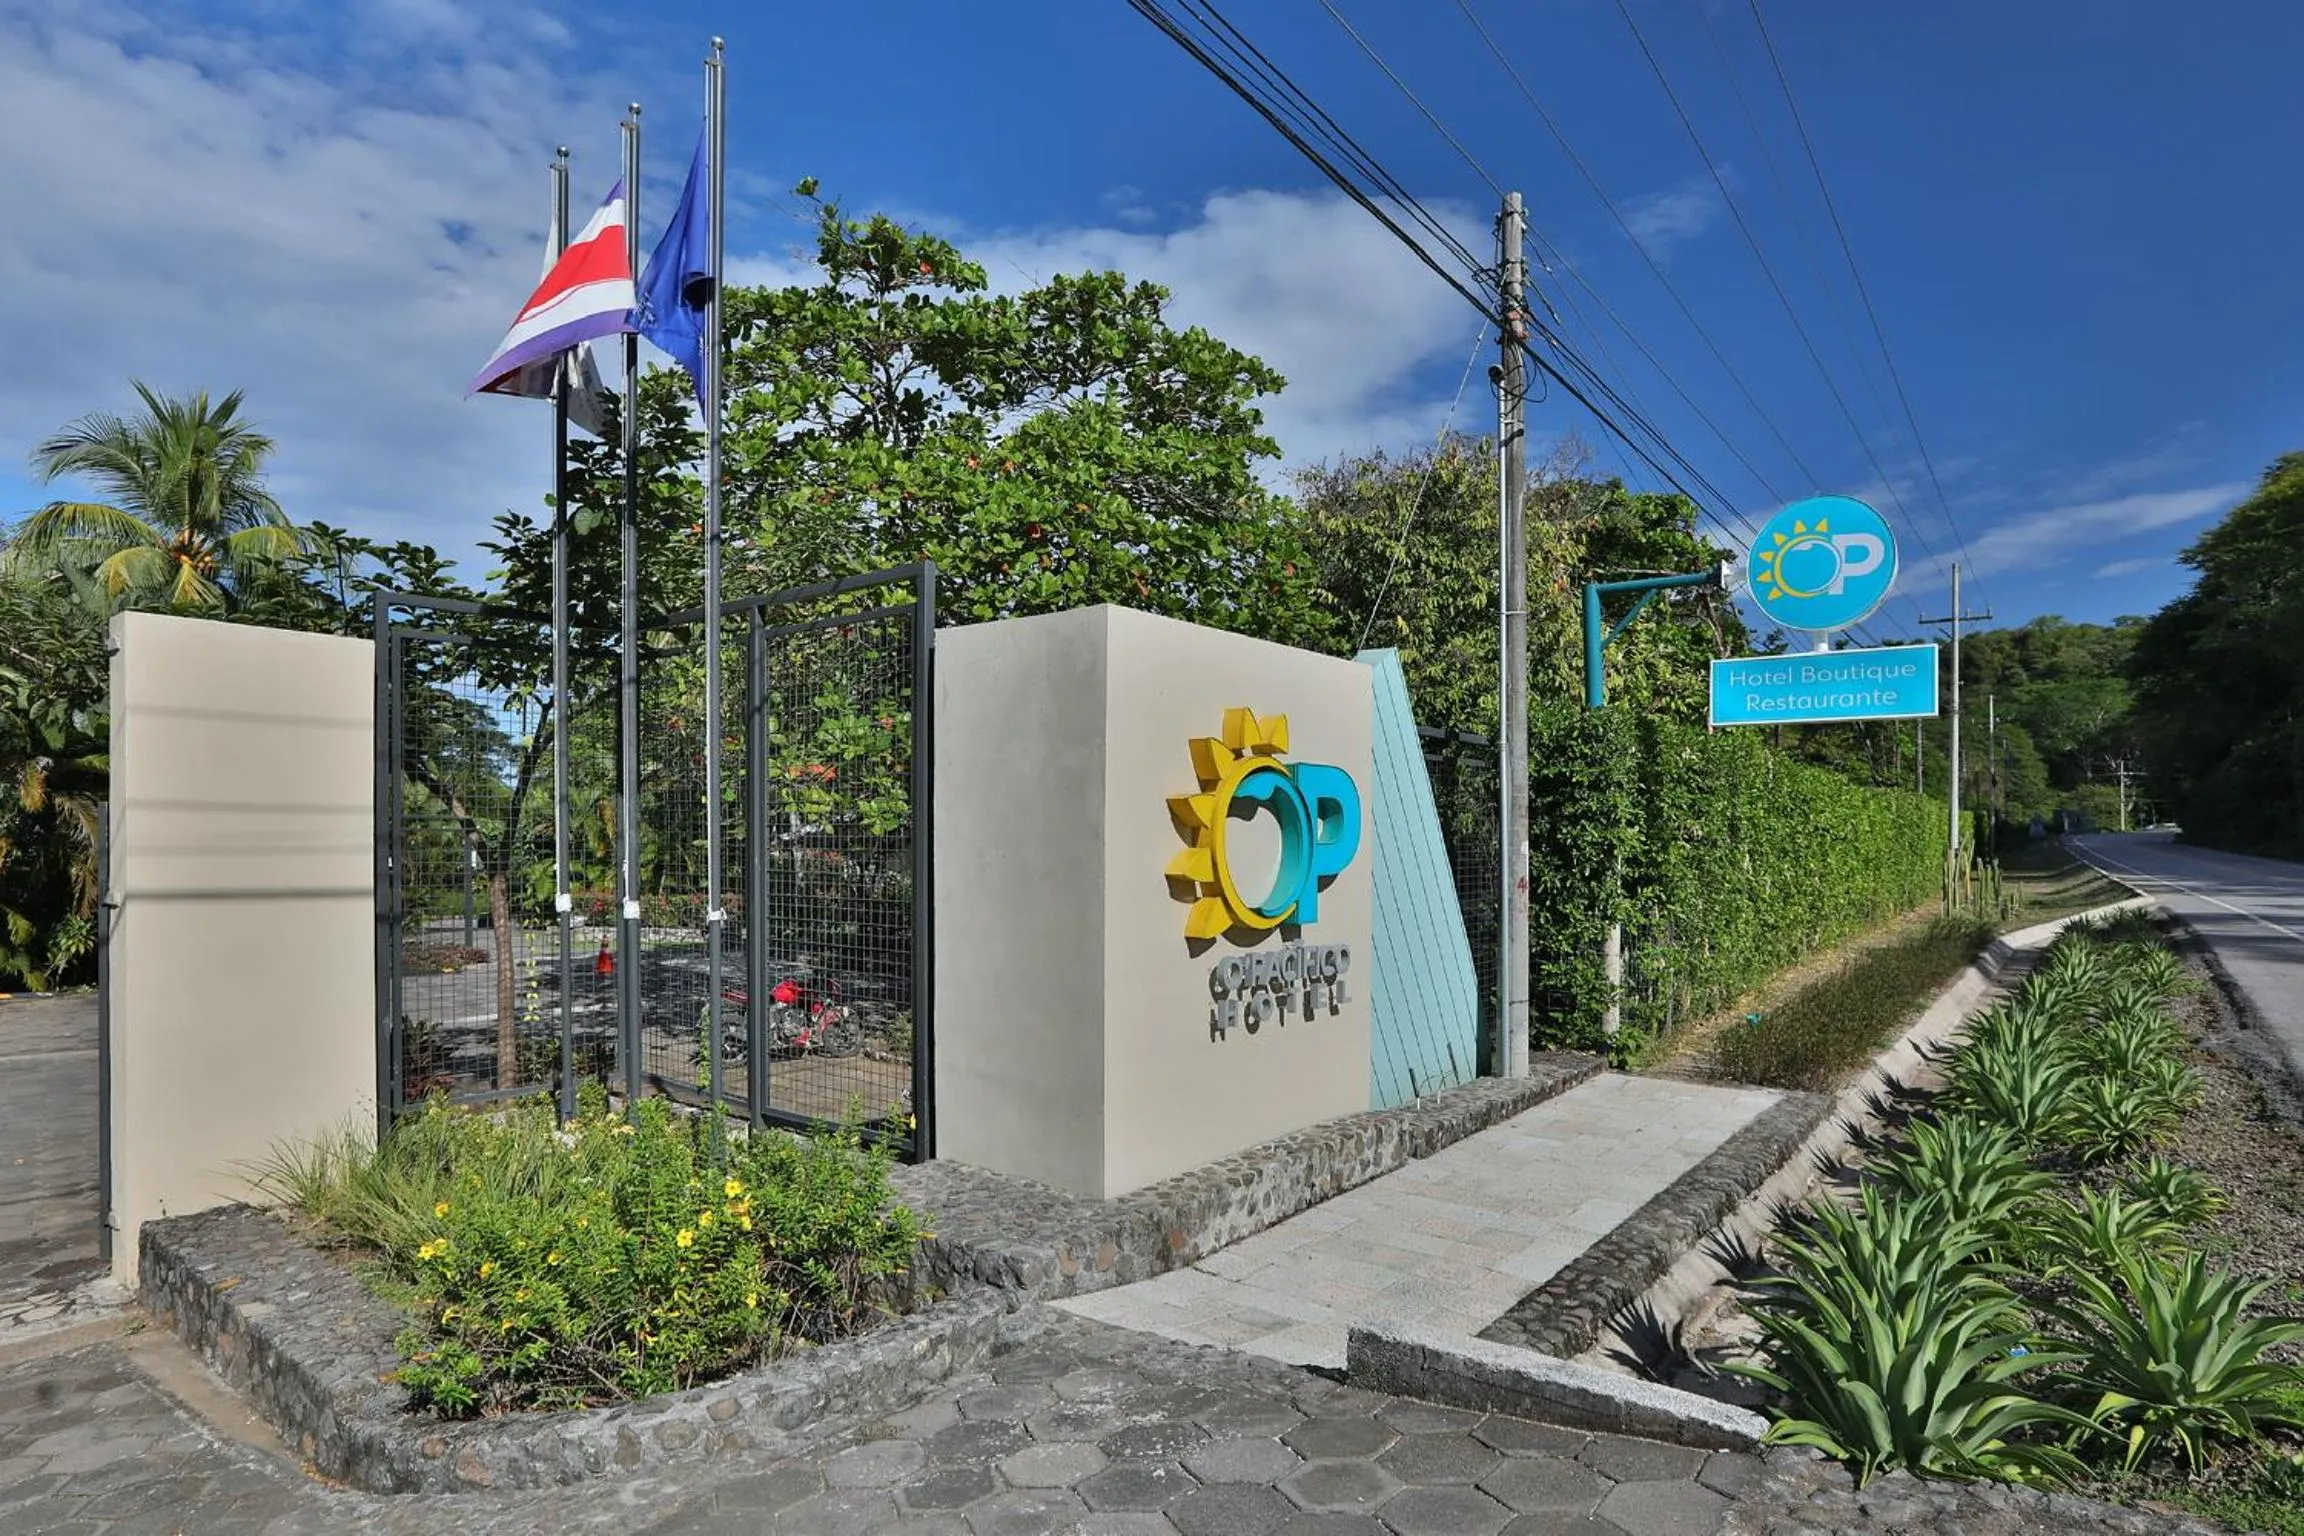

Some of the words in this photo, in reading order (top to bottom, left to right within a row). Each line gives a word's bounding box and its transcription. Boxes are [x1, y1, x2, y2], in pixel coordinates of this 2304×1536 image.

[1730, 666, 1792, 687] Hotel
[1801, 663, 1917, 684] Boutique
[1747, 688, 1898, 712] Restaurante
[1217, 979, 1352, 1029] HOTEL
